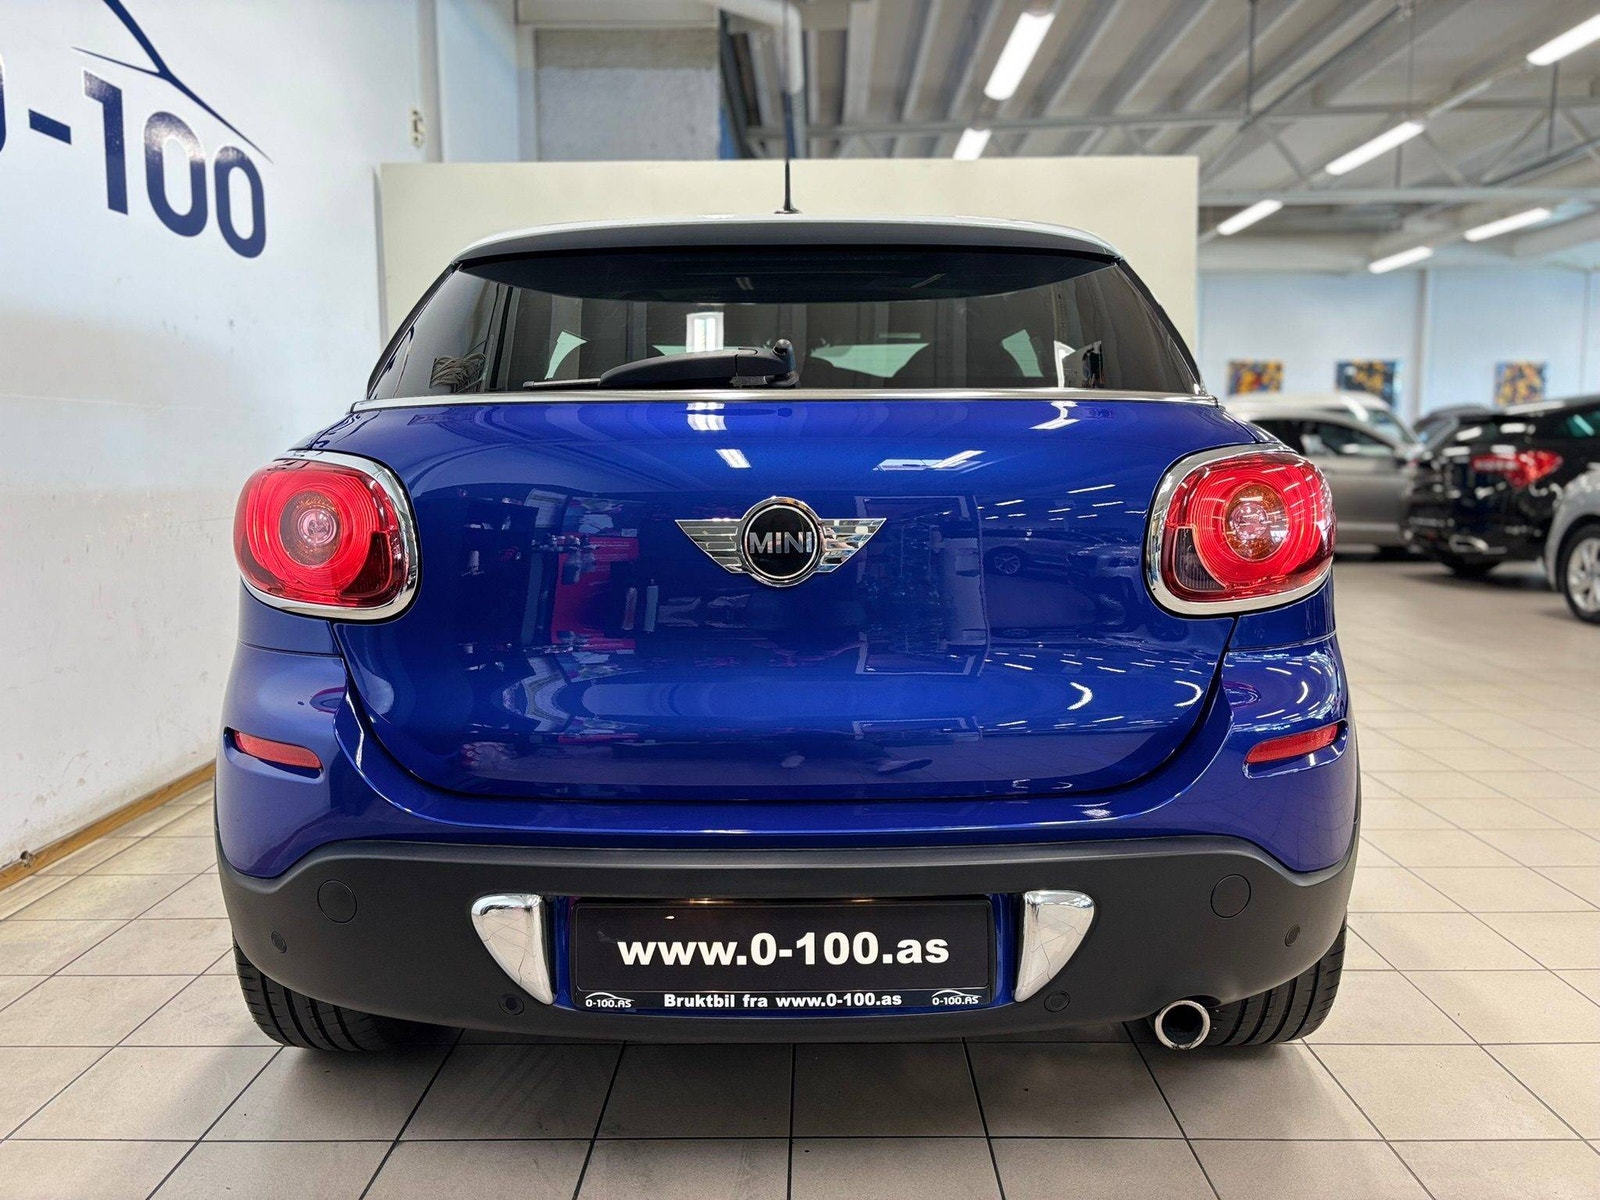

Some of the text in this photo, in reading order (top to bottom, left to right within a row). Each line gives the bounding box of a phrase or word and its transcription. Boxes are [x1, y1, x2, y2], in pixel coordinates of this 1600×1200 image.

[0, 52, 266, 258] -100
[750, 531, 813, 553] MINI
[617, 931, 949, 966] www.0-100.as
[664, 993, 902, 1008] Bruktbil fra www.0-100.as
